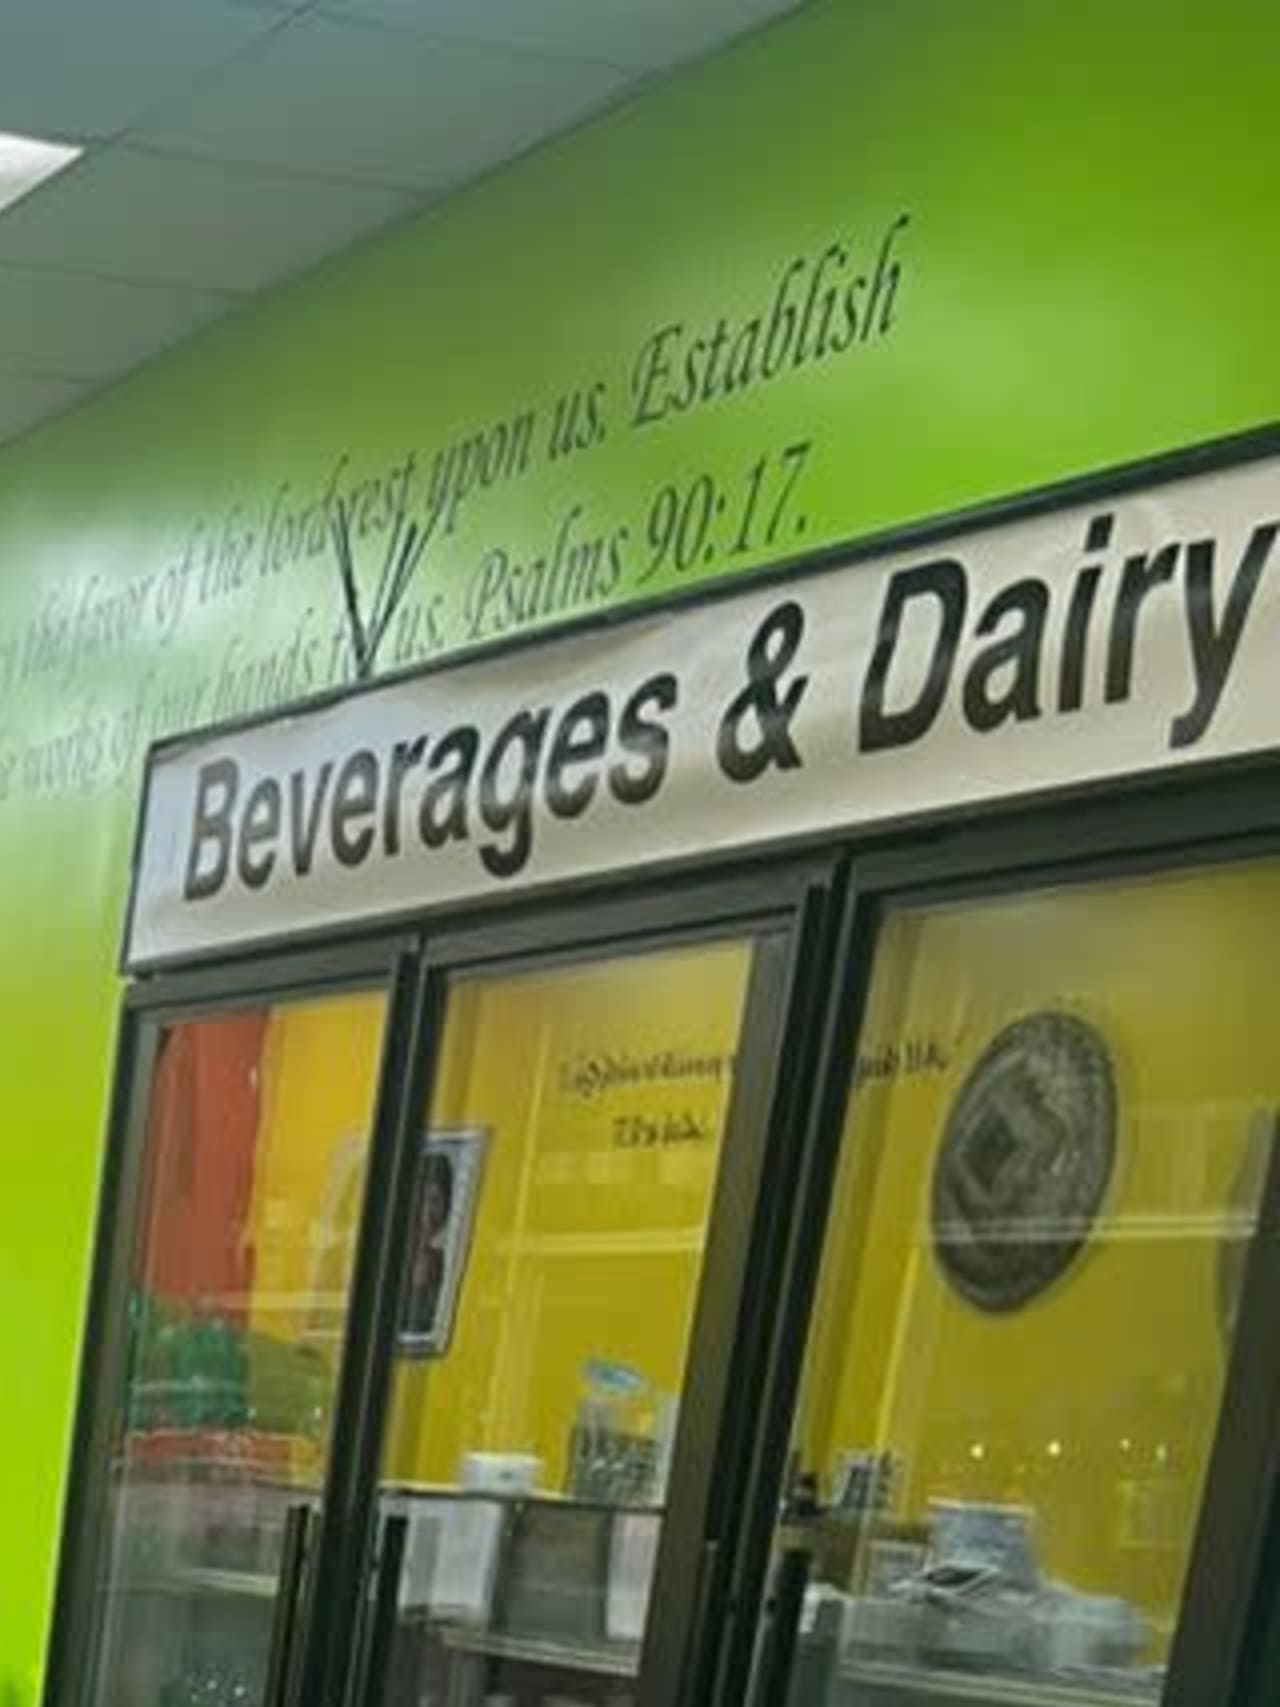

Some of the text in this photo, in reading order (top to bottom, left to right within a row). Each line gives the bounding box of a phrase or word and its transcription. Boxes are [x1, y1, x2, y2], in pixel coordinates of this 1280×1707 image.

[153, 518, 204, 647] of
[198, 503, 256, 603] the
[354, 453, 416, 537] rest
[426, 410, 535, 535] upon
[548, 382, 607, 462] us.
[630, 212, 911, 429] Establish
[394, 594, 446, 664] us.
[466, 503, 630, 640] Psalms
[640, 441, 812, 584] 90:17.
[182, 514, 1280, 904] Beverages & Dairy
